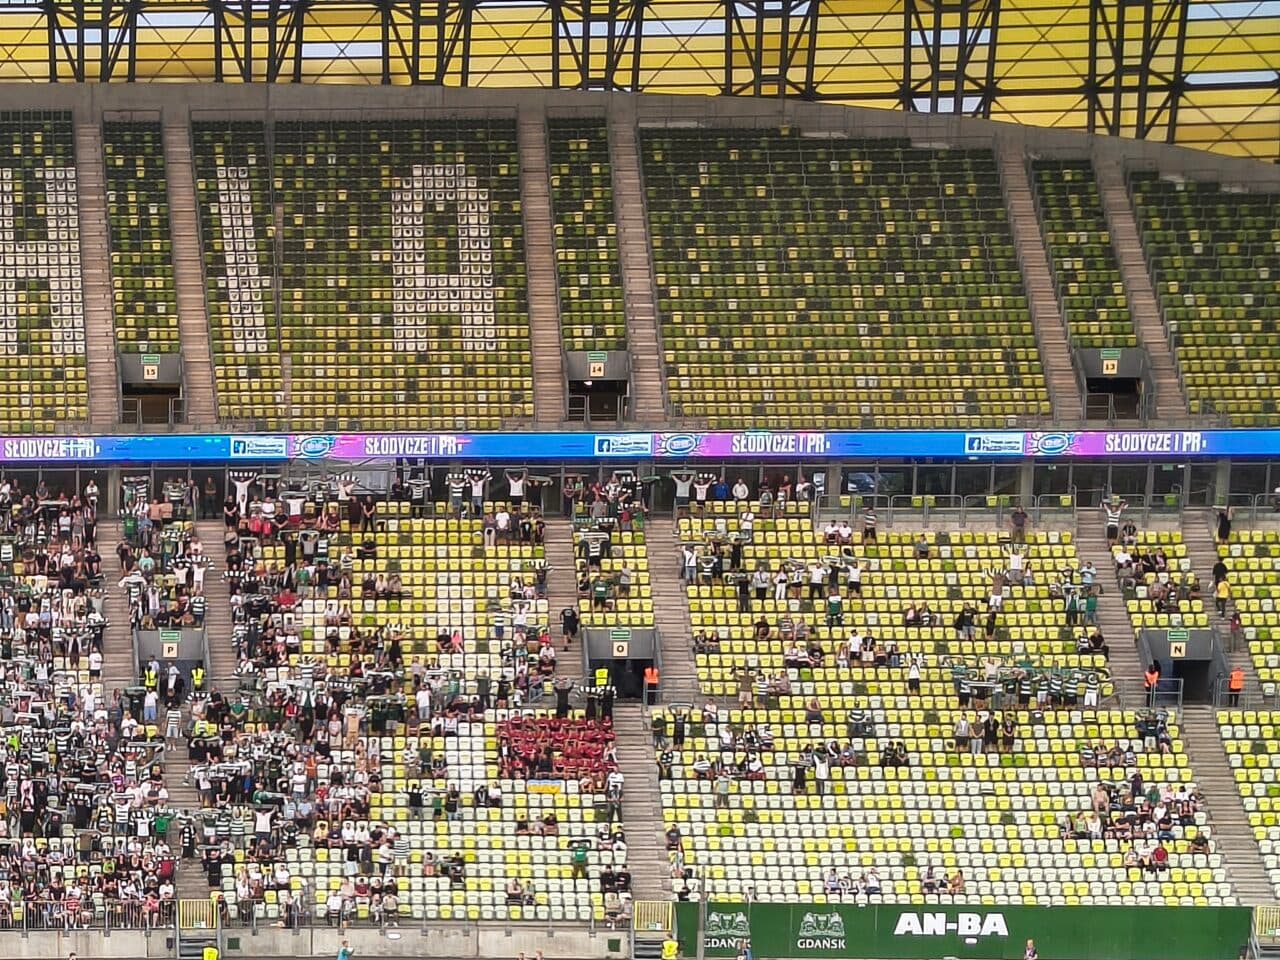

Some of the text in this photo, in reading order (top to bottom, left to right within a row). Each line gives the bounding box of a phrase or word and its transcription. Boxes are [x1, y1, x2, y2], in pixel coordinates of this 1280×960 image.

[4, 439, 66, 457] SŁODYCZE
[365, 437, 428, 455] SŁODYCZE
[732, 435, 795, 452] SŁODYCZE
[1105, 434, 1171, 451] SŁODYCZE
[894, 912, 1009, 936] AN-BA
[704, 937, 751, 949] GDAŃK
[797, 937, 846, 949] GDAŃSK
